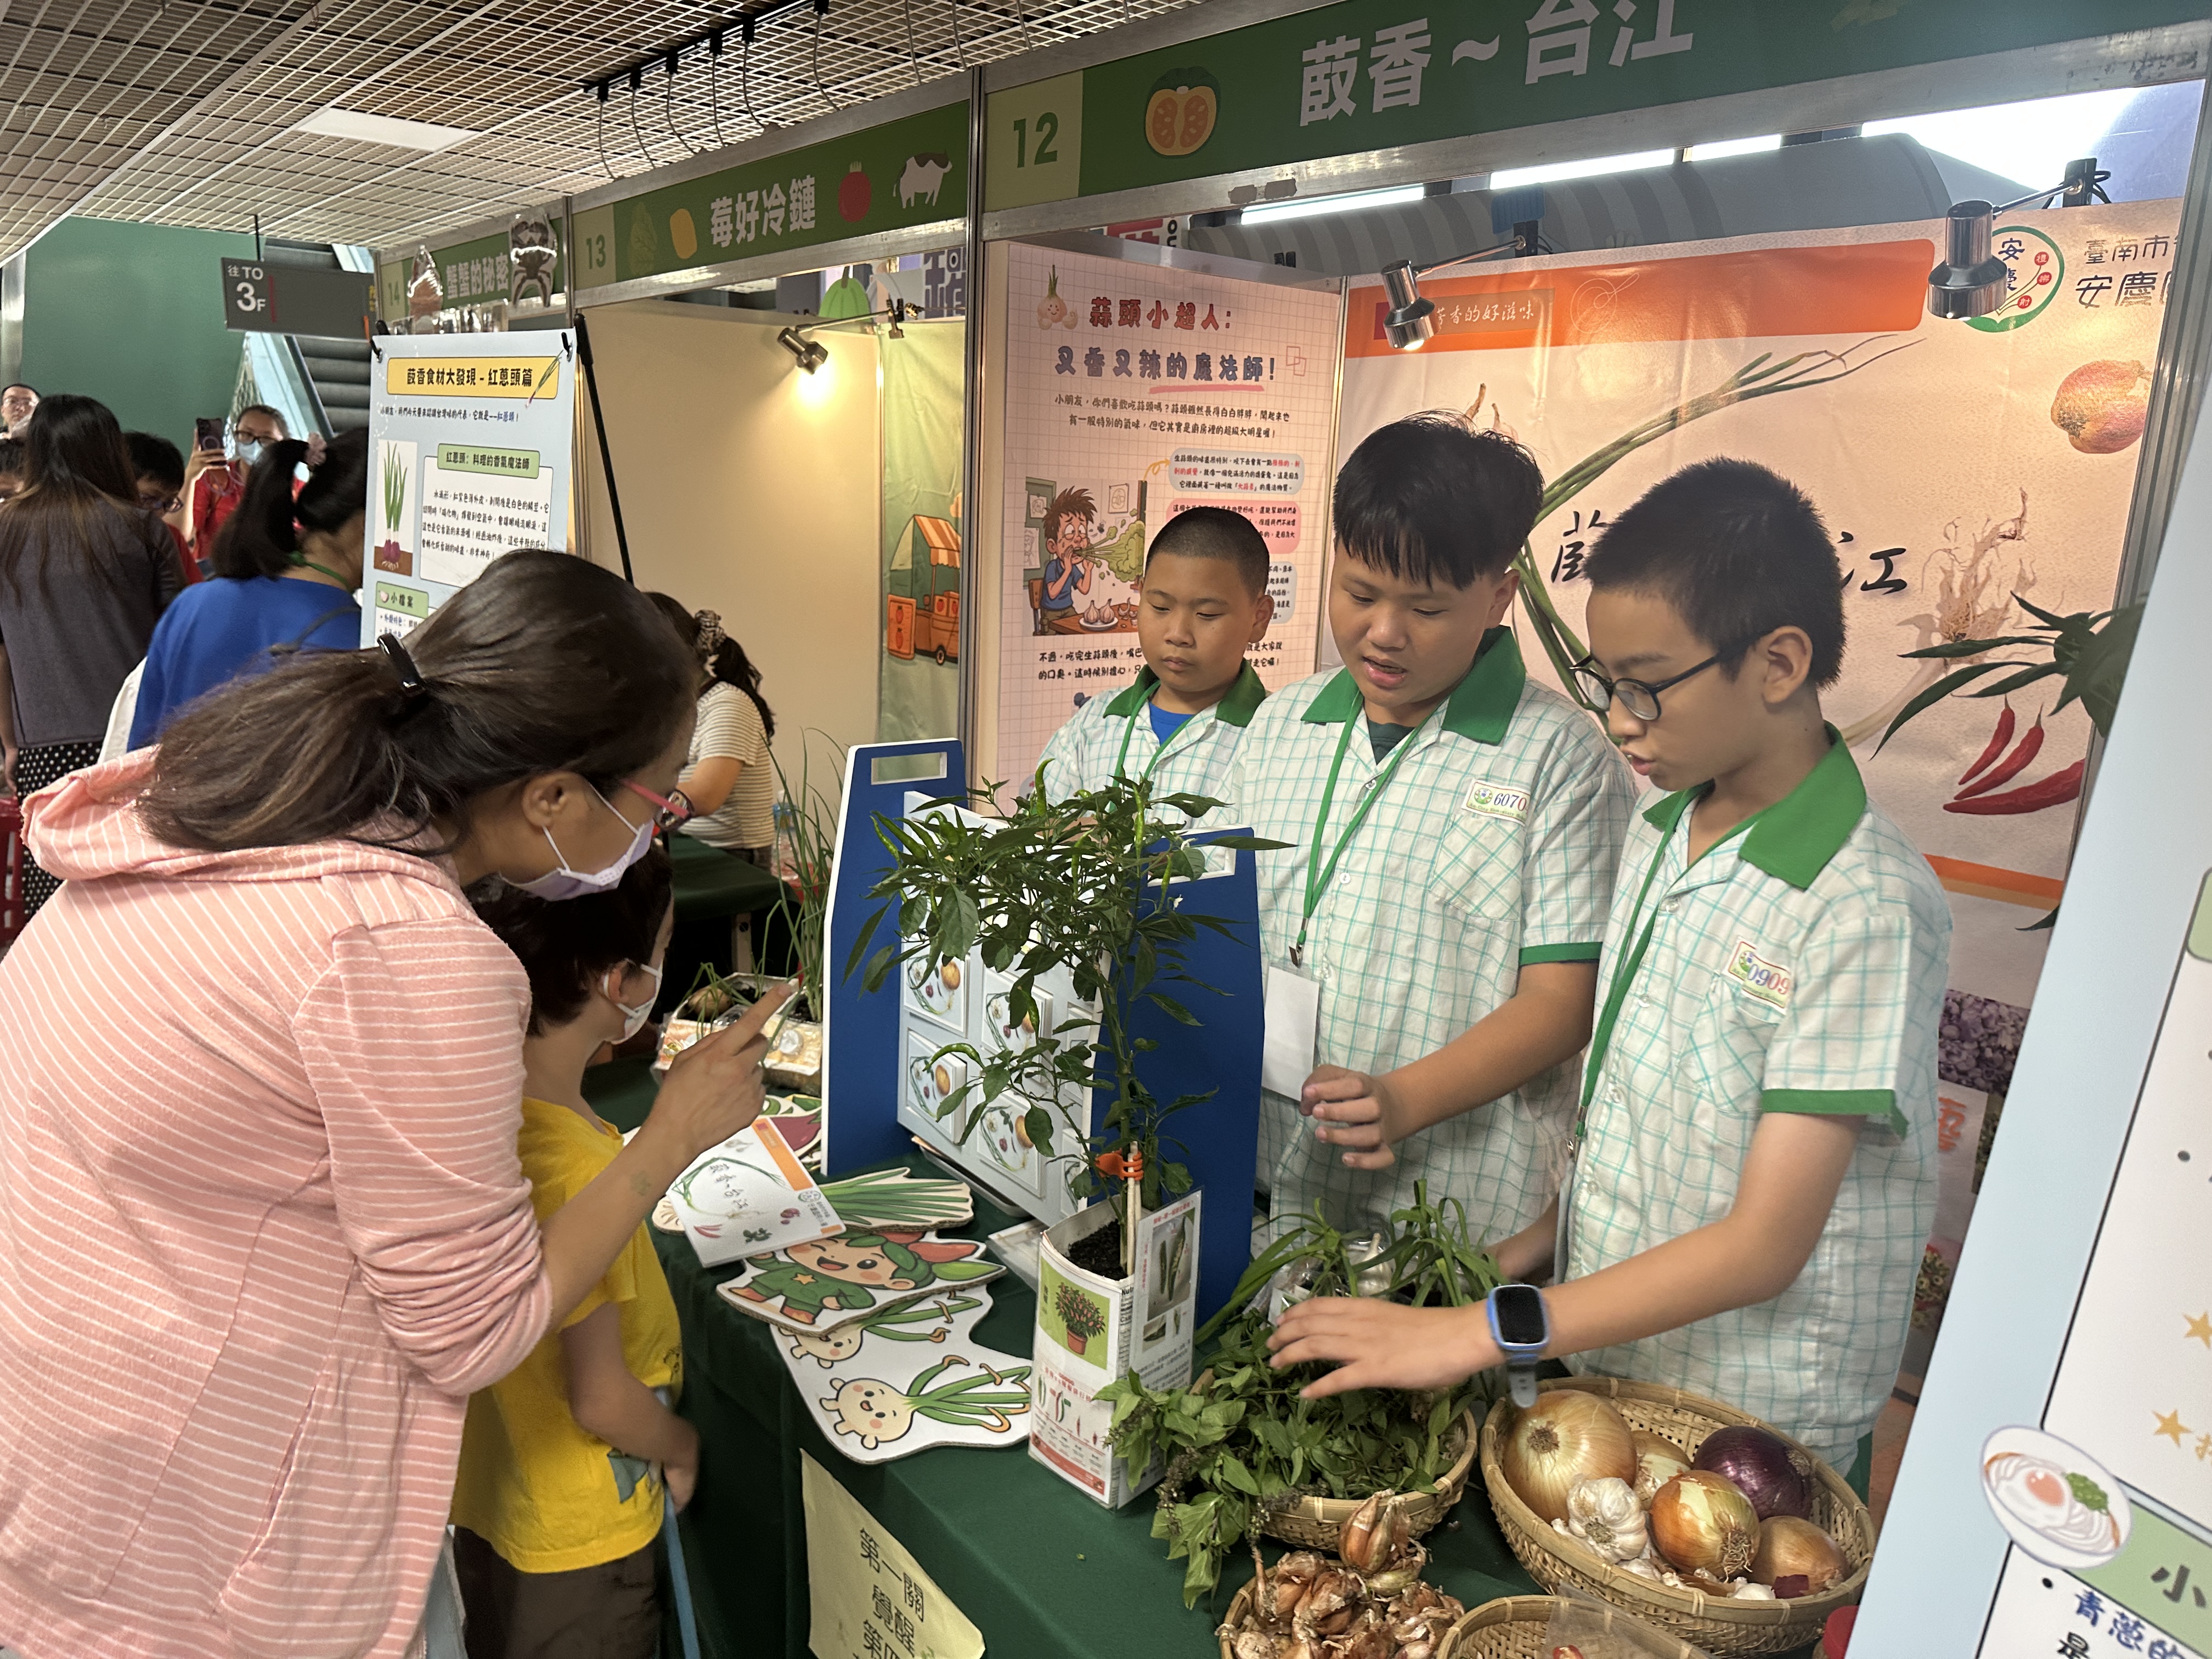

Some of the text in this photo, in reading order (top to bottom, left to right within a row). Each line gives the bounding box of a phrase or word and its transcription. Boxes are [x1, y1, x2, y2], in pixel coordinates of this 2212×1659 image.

[1014, 112, 1059, 168] 12
[711, 174, 815, 247] 莓好冷鏈
[586, 234, 606, 269] 13
[2084, 235, 2179, 264] 臺南市
[242, 267, 263, 280] TO
[447, 252, 509, 299] 蟹蟹的秘密
[2075, 270, 2172, 309] 安慶
[388, 281, 400, 306] 14
